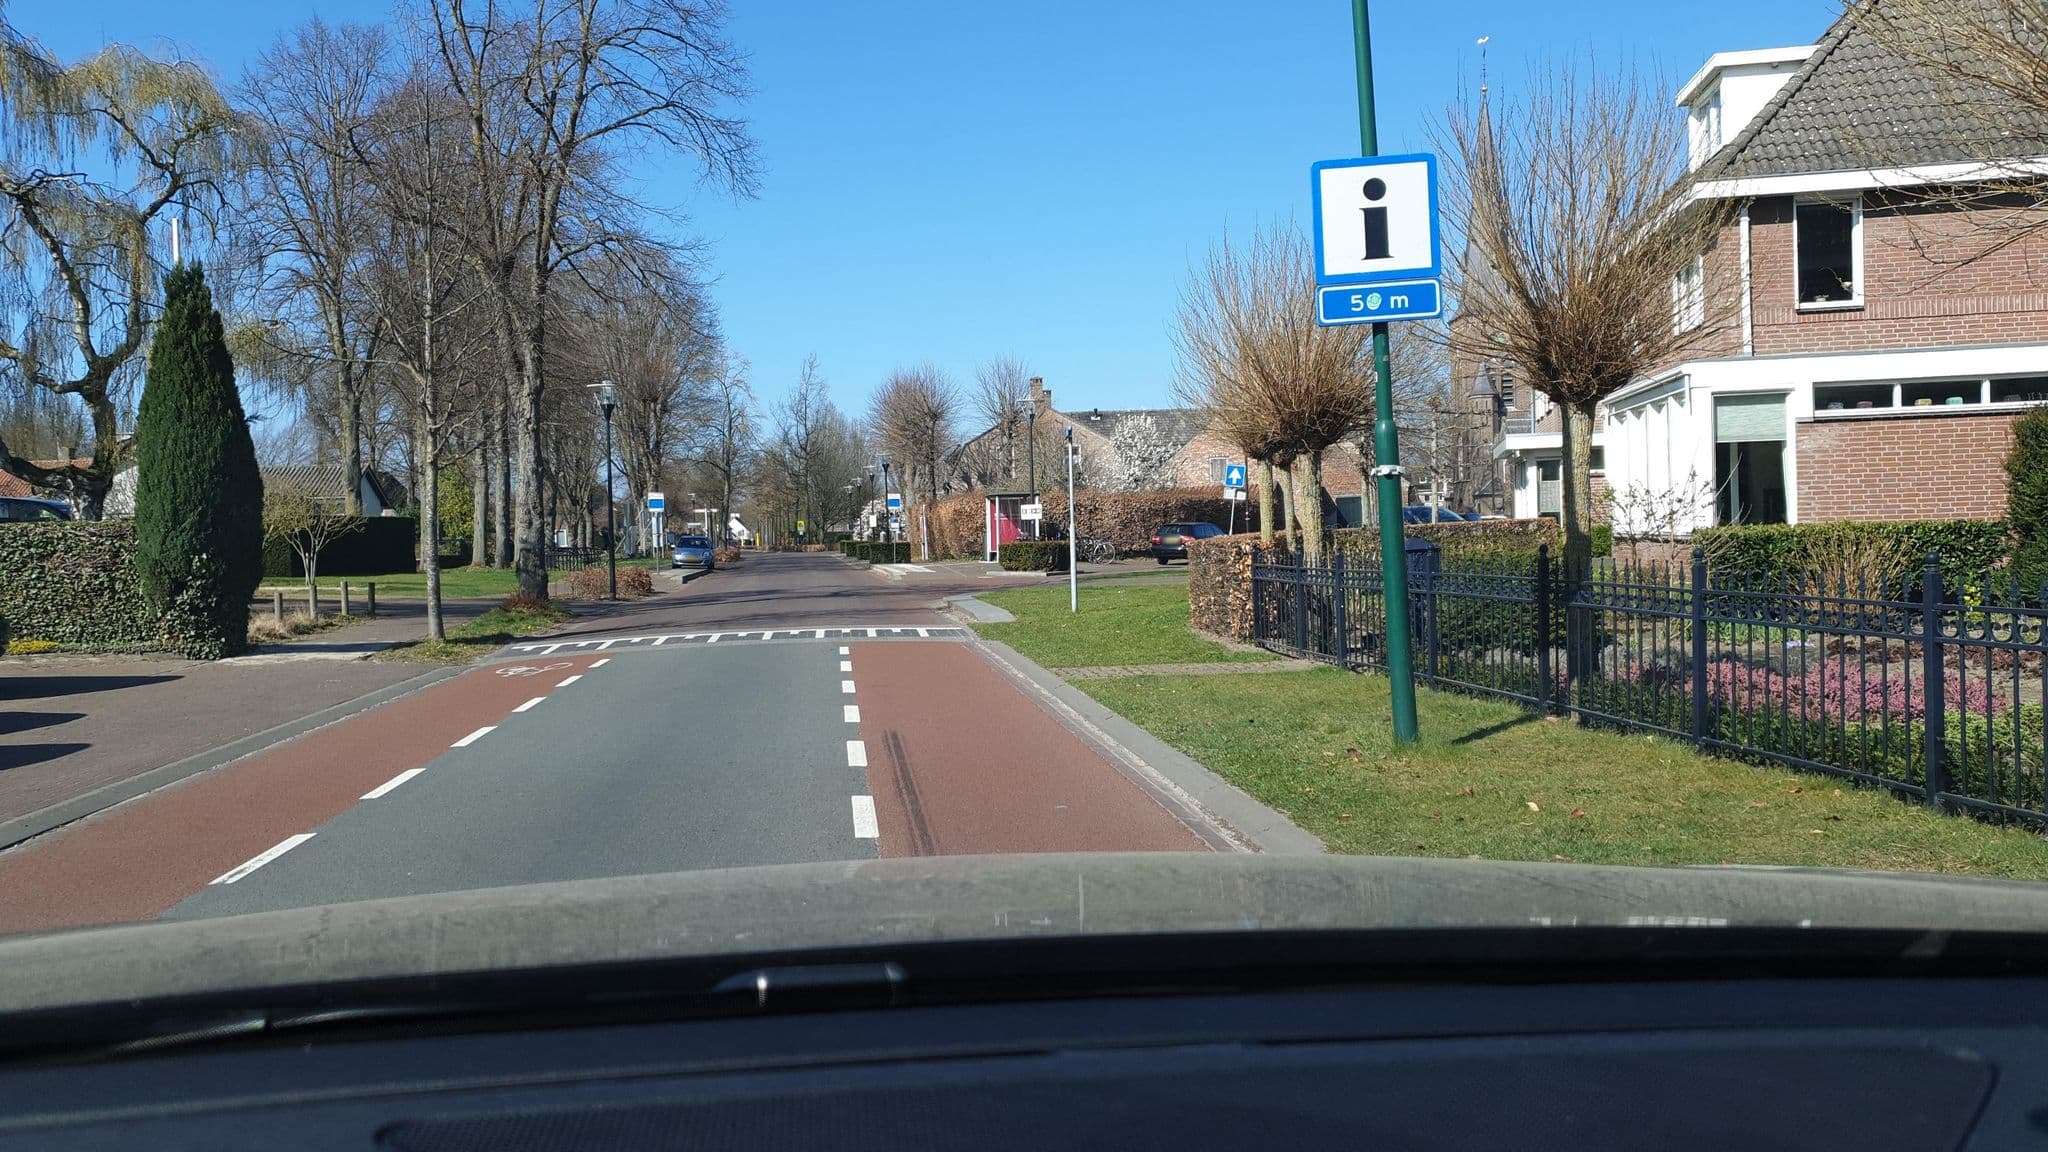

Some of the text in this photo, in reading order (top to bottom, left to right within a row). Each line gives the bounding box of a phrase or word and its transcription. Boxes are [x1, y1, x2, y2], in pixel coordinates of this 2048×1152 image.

[1359, 177, 1395, 261] i
[1350, 292, 1409, 312] 50 m
